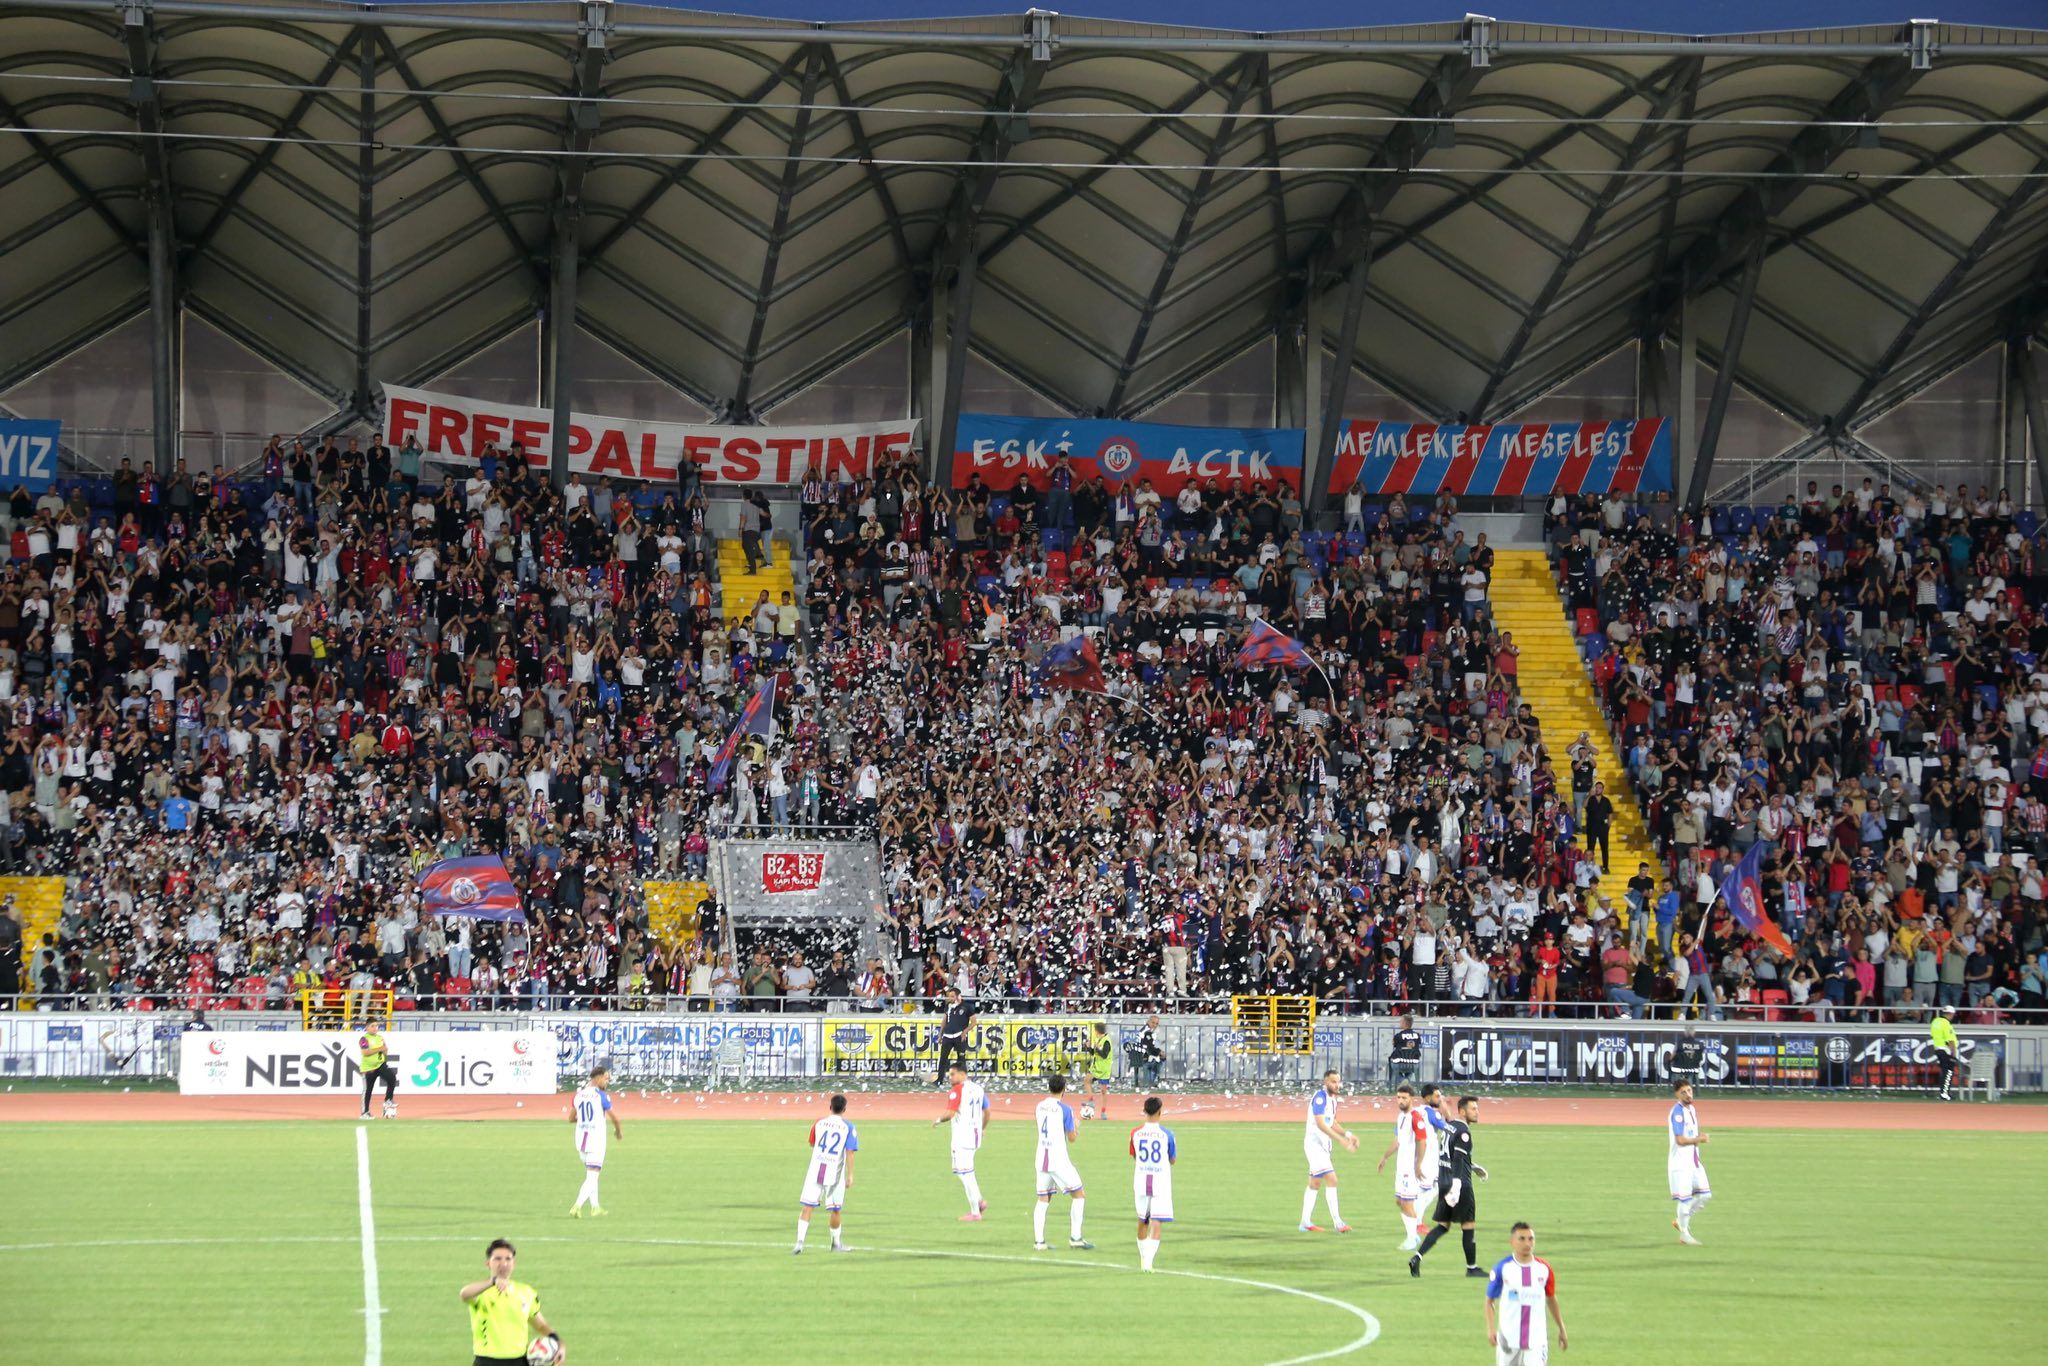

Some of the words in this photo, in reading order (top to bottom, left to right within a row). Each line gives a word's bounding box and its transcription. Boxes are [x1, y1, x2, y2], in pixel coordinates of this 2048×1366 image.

[389, 398, 550, 466] FREE
[567, 424, 911, 484] PALESTINE
[1334, 430, 1483, 459] MEMLEKET
[1499, 421, 1633, 460] MESELESİ
[767, 857, 785, 875] B2
[798, 857, 817, 875] B3
[1452, 1032, 1567, 1077] GÜZEL
[578, 1100, 594, 1122] 10
[1041, 1115, 1048, 1138] 4
[817, 1130, 841, 1155] 42
[1138, 1139, 1161, 1163] 58
